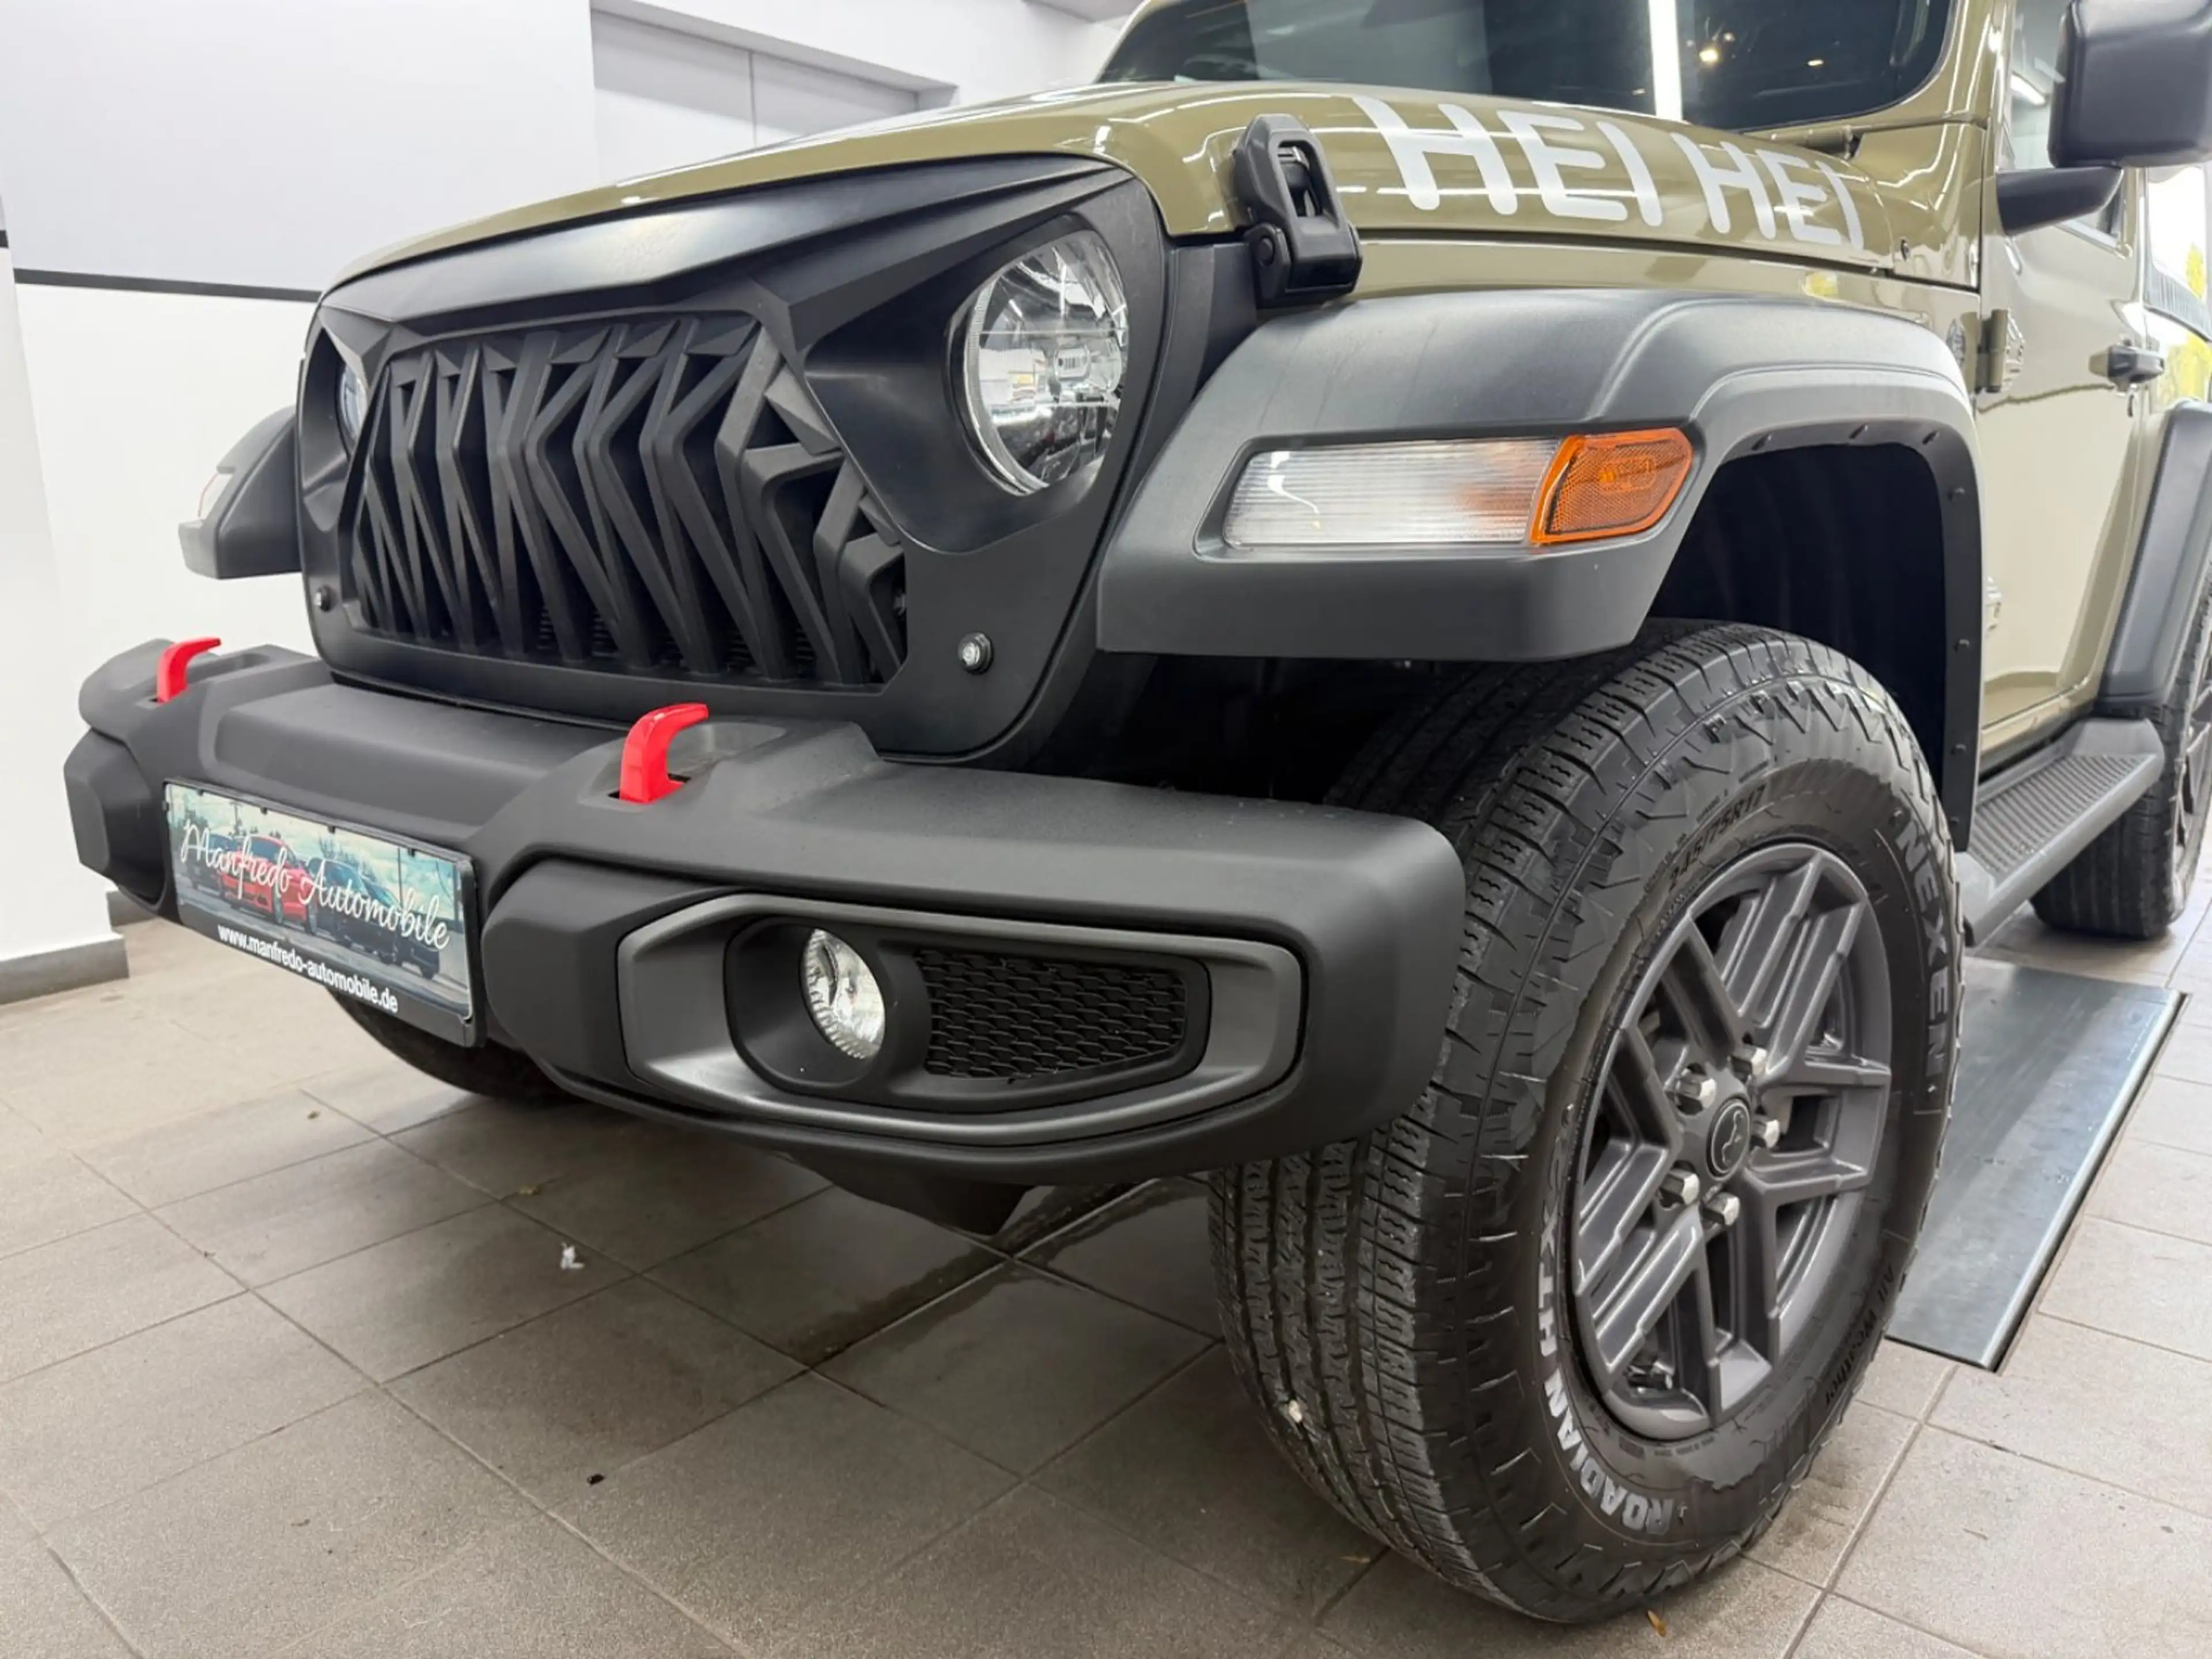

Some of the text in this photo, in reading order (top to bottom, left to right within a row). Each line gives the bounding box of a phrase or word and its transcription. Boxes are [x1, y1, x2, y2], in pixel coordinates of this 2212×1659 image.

[1353, 94, 1865, 250] HEI HEI
[180, 819, 451, 950] Manfredo Automobile
[1895, 815, 1950, 1077] NEXEN
[218, 925, 399, 1014] www.manfredo-automobile.de
[1538, 1203, 1558, 1358] HTX
[1544, 1367, 1674, 1536] ROADIAN
